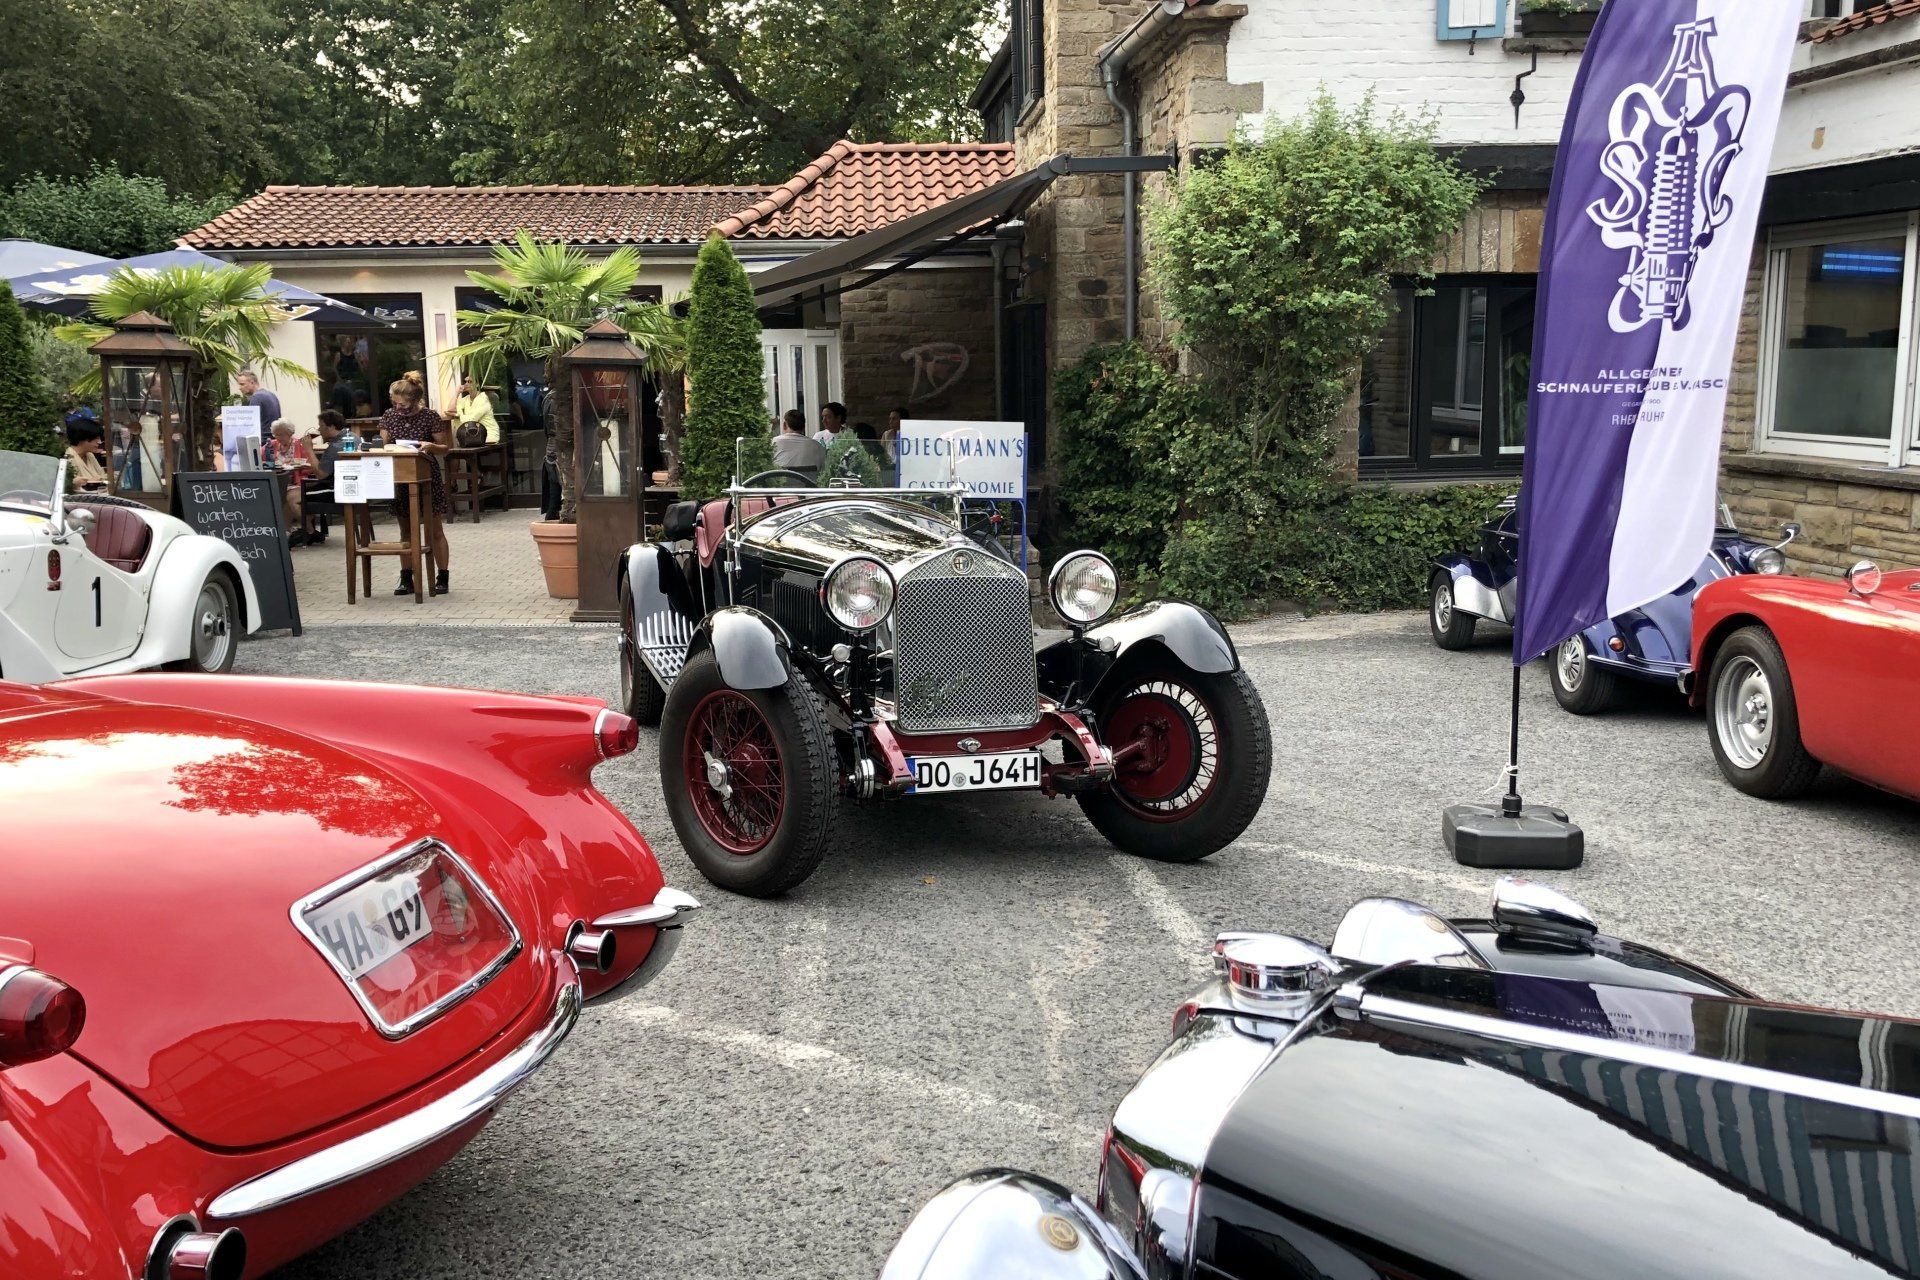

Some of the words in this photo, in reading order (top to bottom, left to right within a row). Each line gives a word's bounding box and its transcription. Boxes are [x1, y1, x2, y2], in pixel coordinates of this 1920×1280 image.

[192, 484, 228, 504] Bitte
[230, 482, 260, 500] hier
[197, 506, 250, 524] warten,
[91, 576, 102, 628] 1
[917, 761, 950, 788] DO
[321, 910, 374, 971] HA
